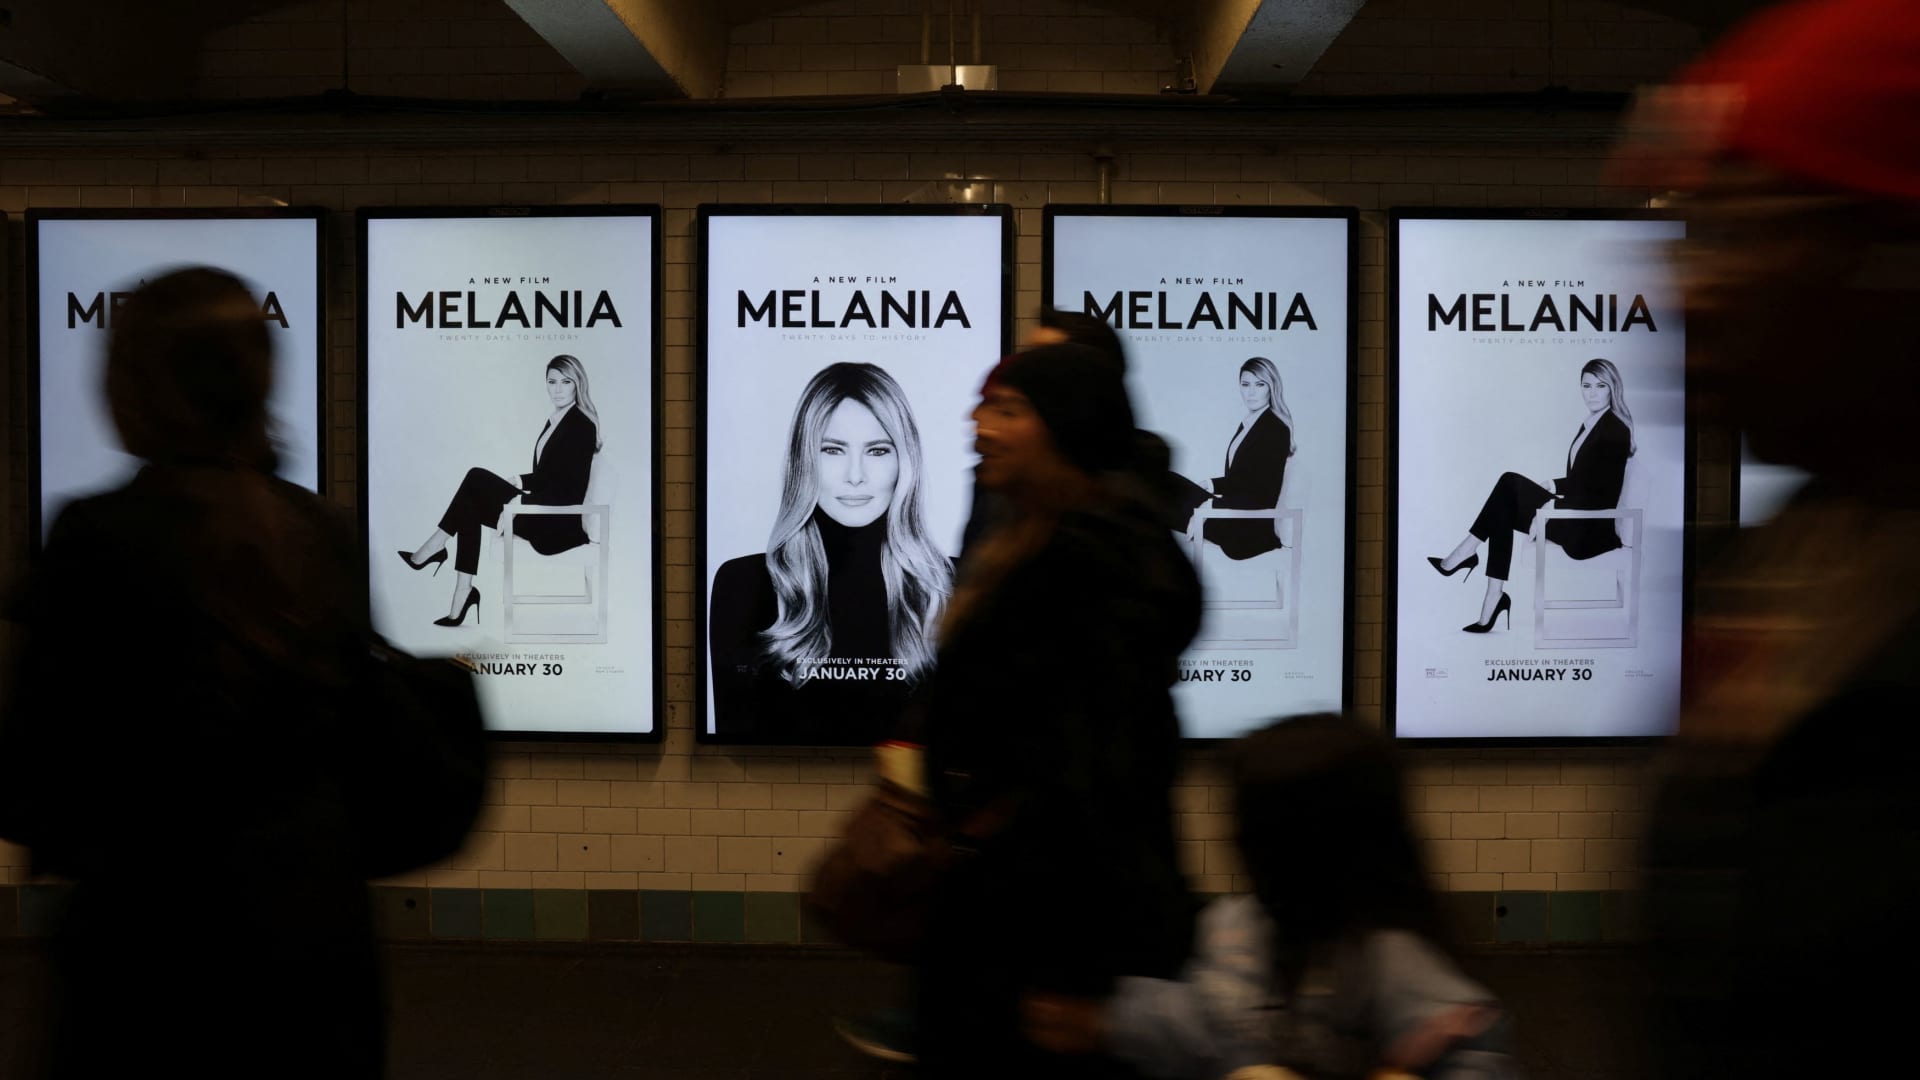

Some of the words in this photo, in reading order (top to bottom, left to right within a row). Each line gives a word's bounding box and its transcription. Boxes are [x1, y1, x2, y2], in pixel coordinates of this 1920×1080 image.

[469, 277, 475, 285] A
[484, 277, 511, 285] NEW
[520, 277, 550, 285] FILM
[813, 276, 820, 284] A
[829, 276, 858, 284] NEW
[866, 276, 897, 284] FILM
[1160, 277, 1167, 285] A
[1176, 277, 1204, 285] NEW
[1213, 277, 1244, 285] FILM
[396, 290, 623, 328] MELANIA
[737, 290, 972, 329] MELANIA
[1083, 290, 1318, 330] MELANIA
[1428, 293, 1658, 332] MELANIA
[796, 657, 852, 665] EXCLUSIVELY
[469, 663, 537, 675] NUARY
[542, 663, 563, 676] 30
[799, 667, 881, 680] JANUARY
[885, 668, 907, 680] 30
[1178, 669, 1226, 682] UARY
[1230, 669, 1252, 682] 30
[1487, 668, 1567, 681] JANUARY
[1571, 668, 1593, 681] 30
